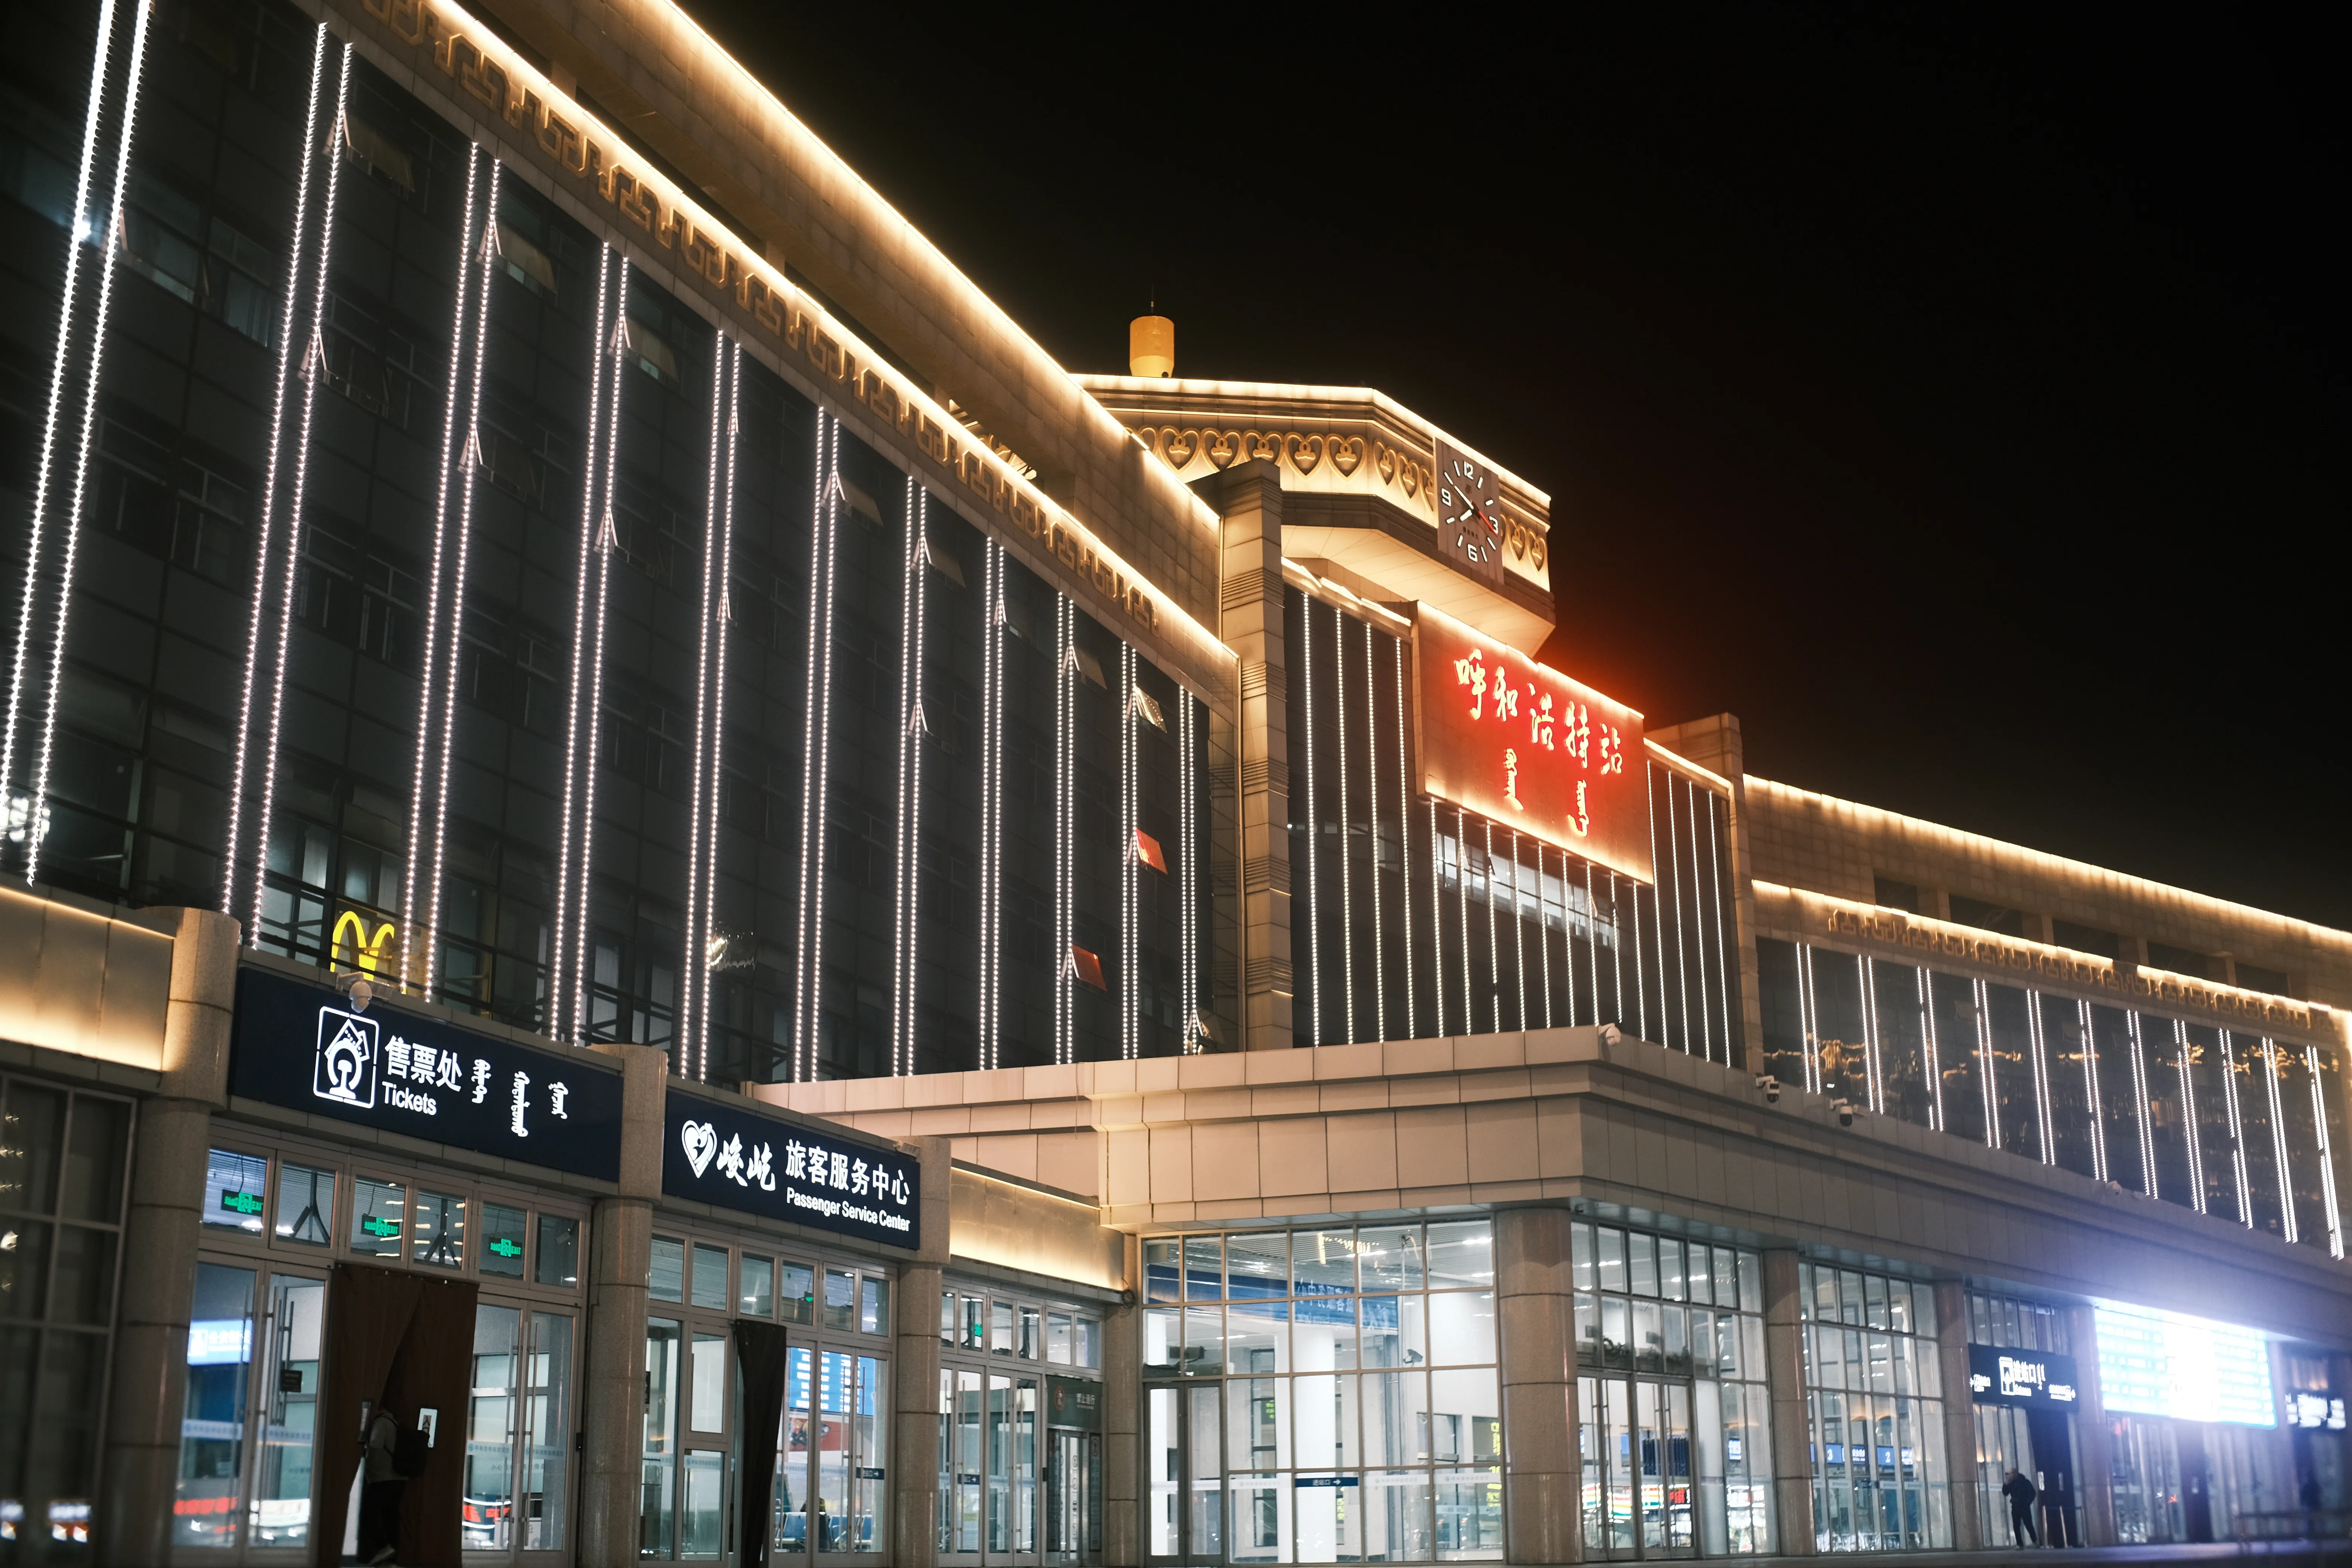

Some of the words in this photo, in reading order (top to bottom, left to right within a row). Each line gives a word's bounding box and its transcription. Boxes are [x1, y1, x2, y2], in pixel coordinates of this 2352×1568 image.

[1463, 461, 1474, 480] 12
[1441, 488, 1452, 507] 9
[1488, 516, 1499, 534] 3
[1467, 543, 1478, 562] 6
[1454, 649, 1622, 775] 呼和浩特站
[384, 1035, 462, 1092] 售票处
[382, 1081, 437, 1115] Tickets
[786, 1139, 910, 1205] 旅客服务中心
[787, 1187, 841, 1217] Passenger
[842, 1200, 878, 1224] Service
[879, 1210, 910, 1231] Center
[1827, 1448, 1833, 1461] 3
[1885, 1451, 1891, 1463] 2
